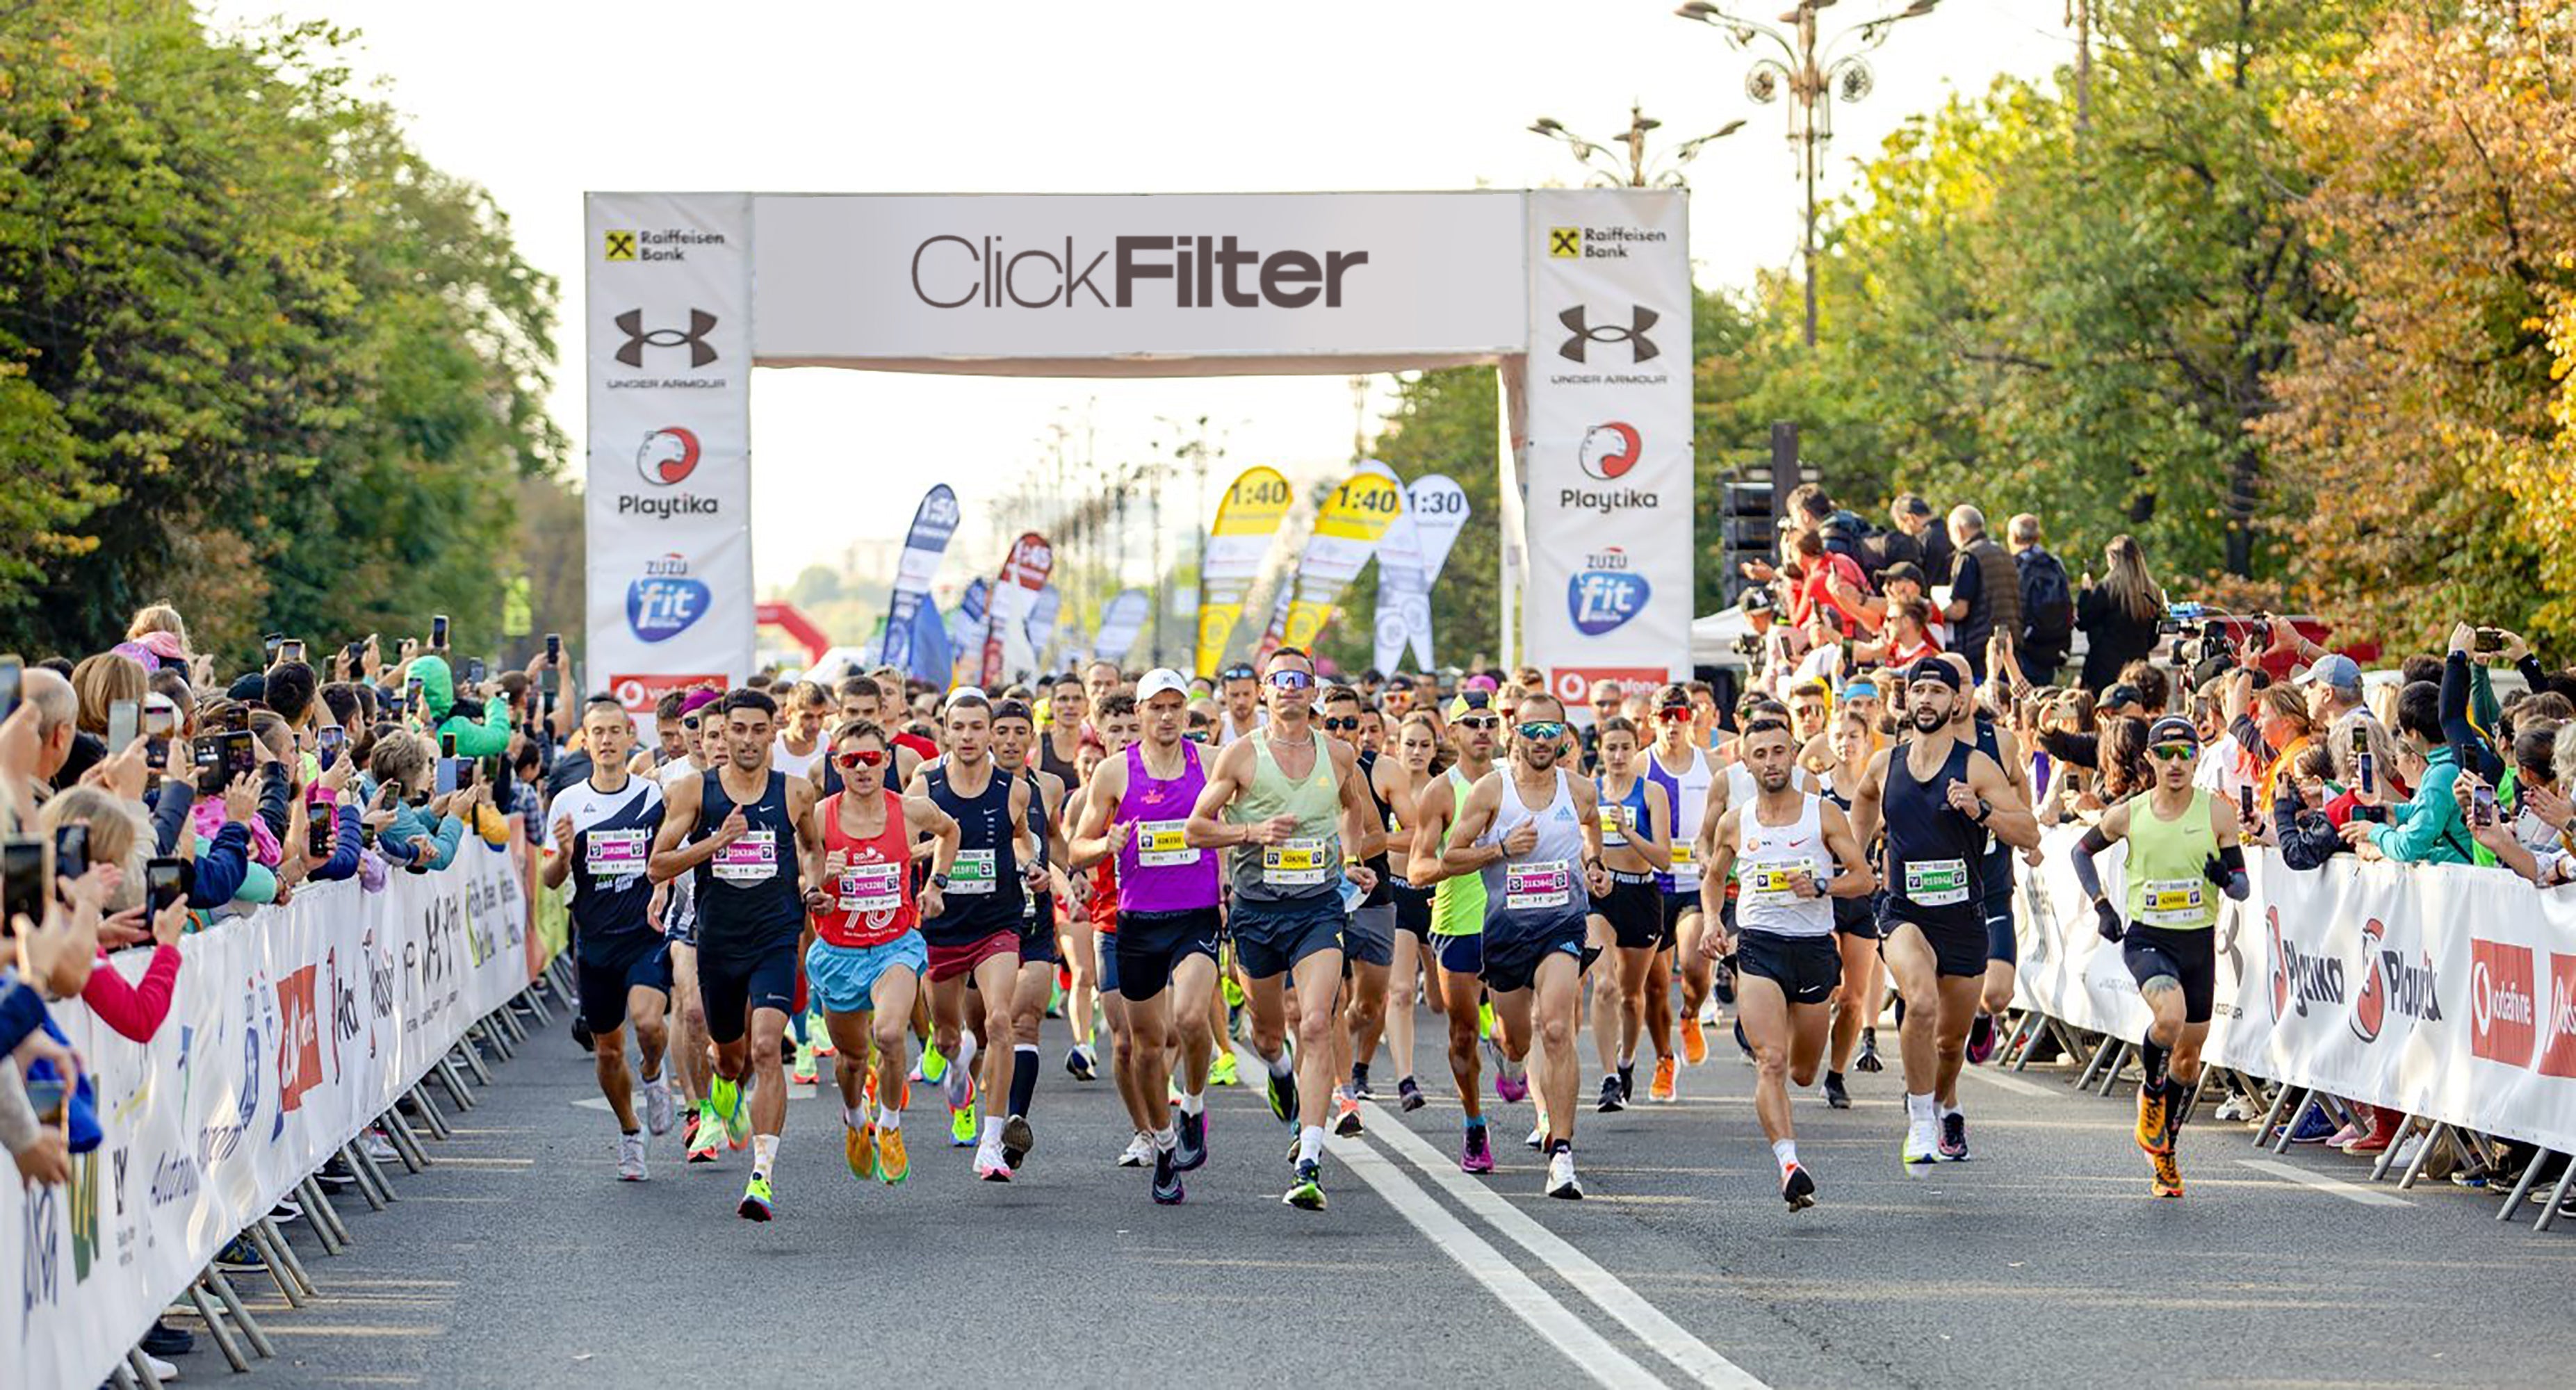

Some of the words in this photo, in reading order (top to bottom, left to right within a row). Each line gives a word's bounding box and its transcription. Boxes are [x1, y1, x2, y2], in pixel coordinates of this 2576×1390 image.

[641, 231, 724, 245] Raiffeisen
[1585, 227, 1667, 242] Raiffeisen
[641, 248, 685, 261] Bank
[1585, 245, 1629, 258] Bank
[911, 235, 1369, 309] ClickFilter
[607, 379, 658, 389] UNDER
[662, 379, 726, 389] ARMOUR
[1551, 375, 1600, 384] UNDER
[1604, 375, 1668, 384] ARMOUR
[1232, 481, 1287, 505] 1:40
[1339, 484, 1397, 513] 1:40
[1408, 491, 1461, 514] 1:30
[1560, 489, 1658, 514] Playtika
[619, 493, 719, 519] Playtika
[637, 582, 694, 629] fit
[1579, 575, 1635, 623] fit
